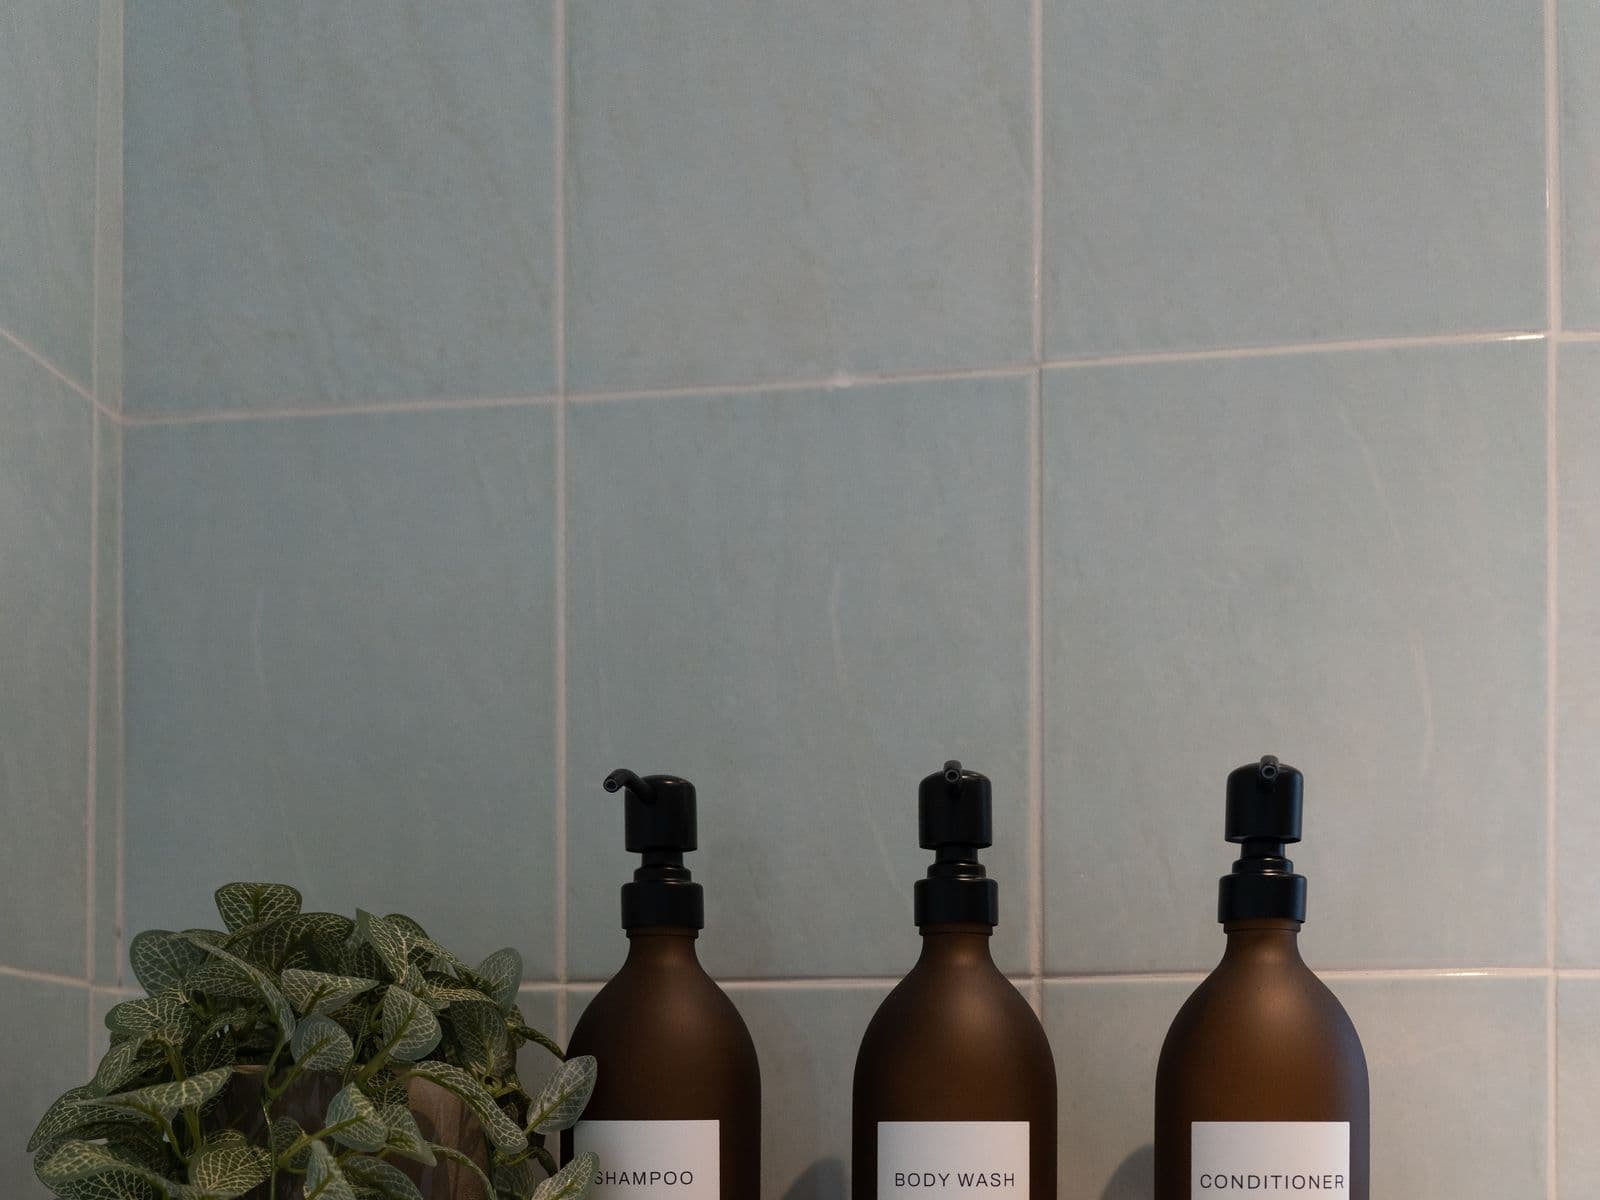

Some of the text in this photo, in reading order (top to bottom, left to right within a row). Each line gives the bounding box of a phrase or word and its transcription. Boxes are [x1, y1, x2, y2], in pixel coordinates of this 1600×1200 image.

[595, 1171, 694, 1186] SHAMPOO
[895, 1172, 1016, 1188] BODY WASH
[1200, 1174, 1345, 1190] CONDITIONER
